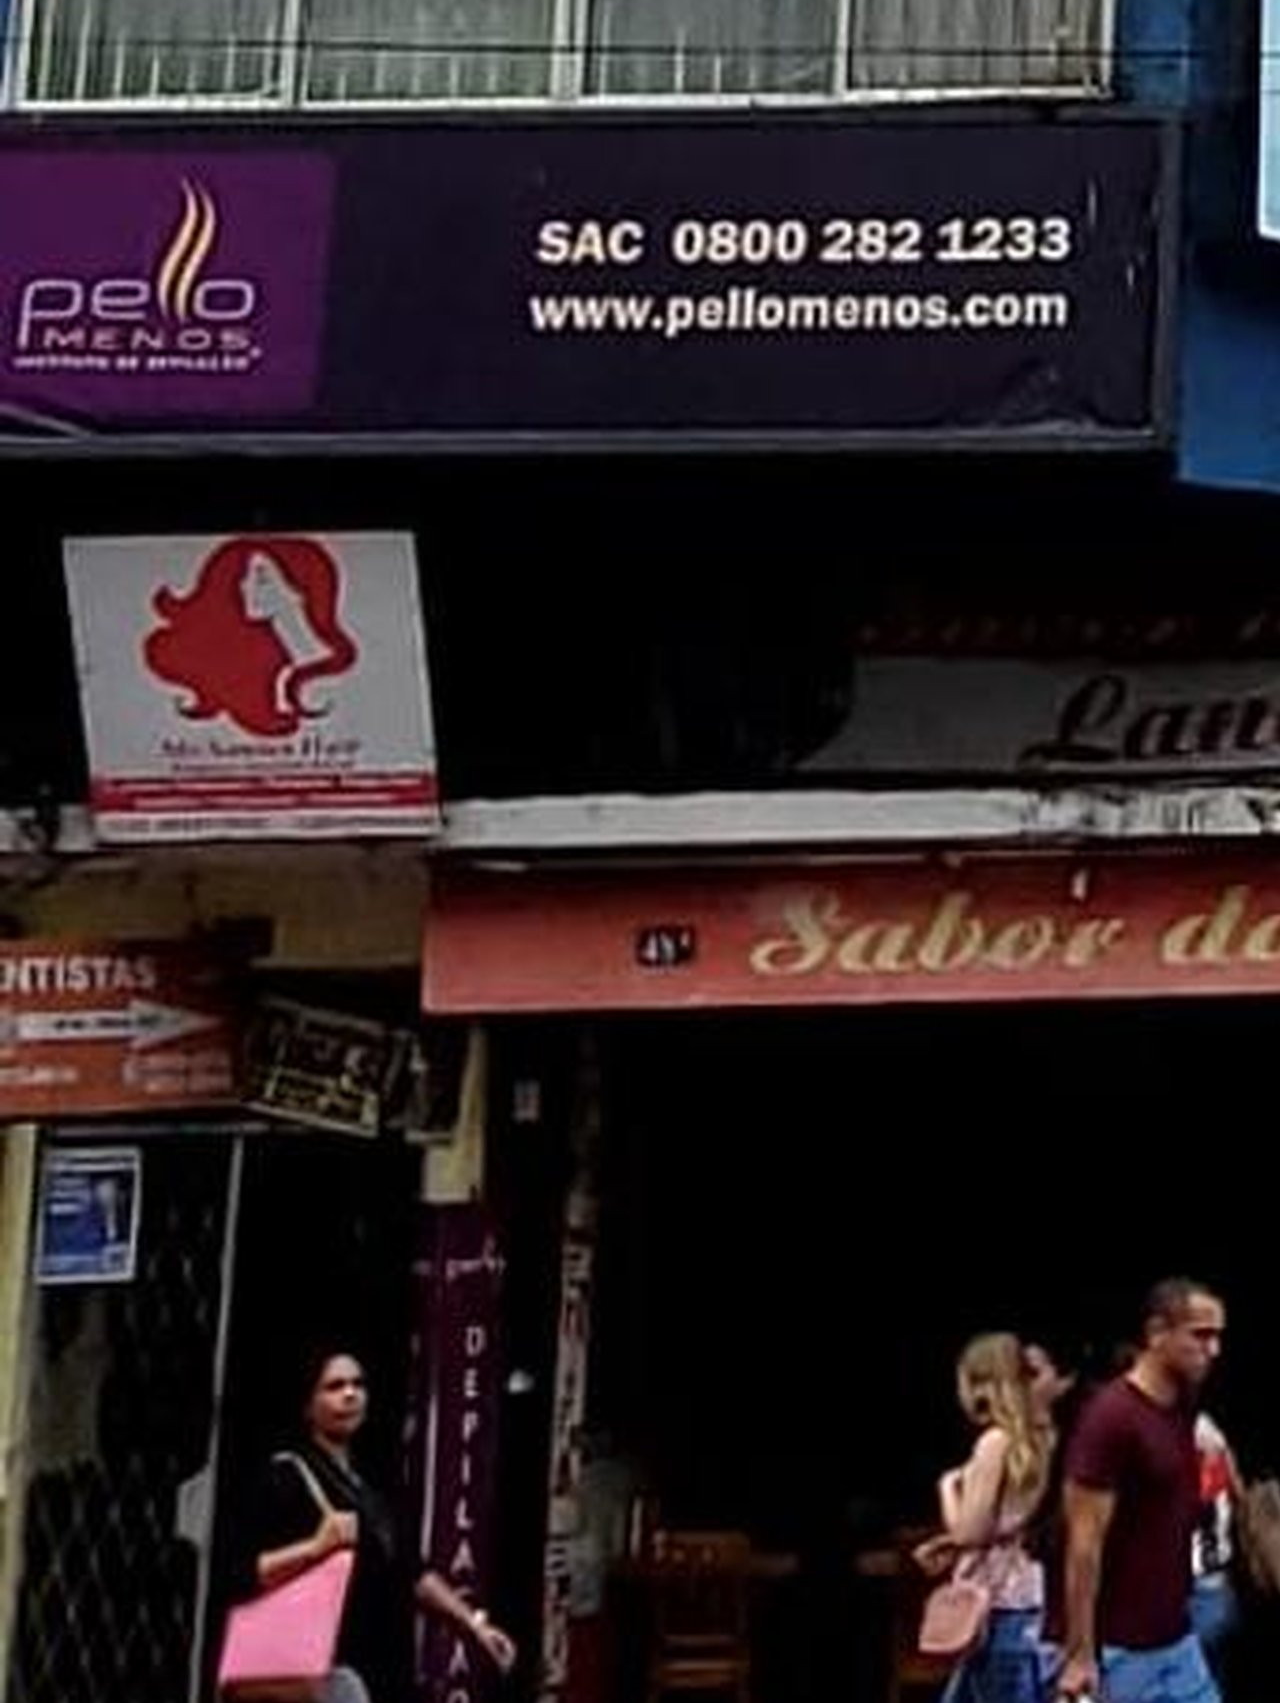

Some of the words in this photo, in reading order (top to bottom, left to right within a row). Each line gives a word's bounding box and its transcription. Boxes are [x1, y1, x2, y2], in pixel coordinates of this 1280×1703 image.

[18, 177, 257, 352] pello
[537, 220, 644, 265] SAC
[672, 219, 808, 263] 0800
[821, 220, 923, 262] 282
[935, 217, 1071, 261] 1233
[530, 287, 1068, 339] www.pellomenos.com
[42, 327, 251, 352] MENOS
[748, 883, 1126, 977] Sabor
[0, 953, 157, 994] NTISTAS
